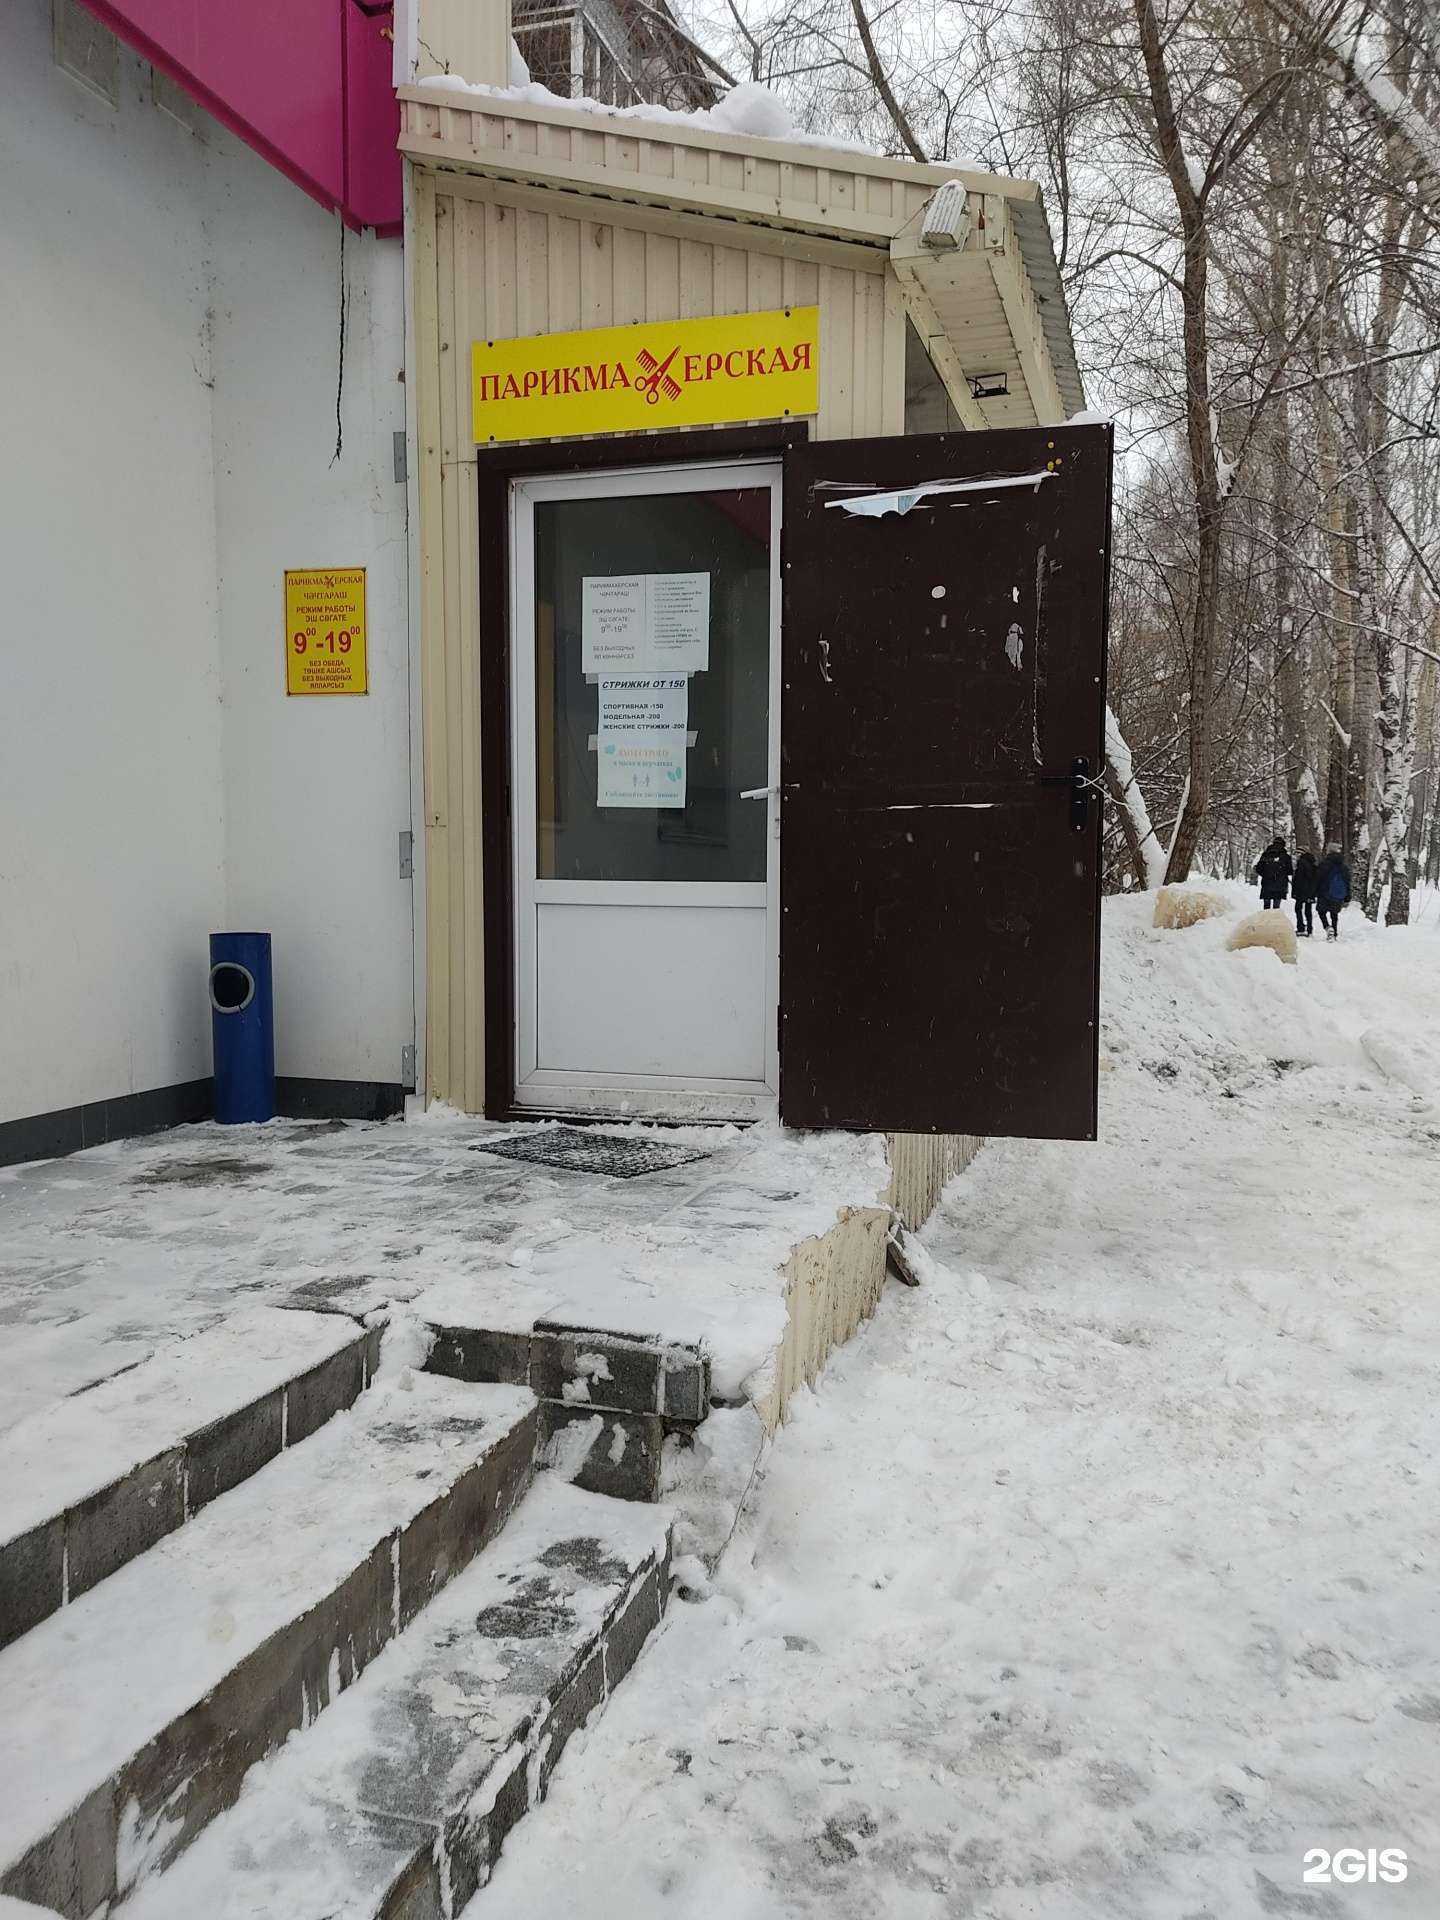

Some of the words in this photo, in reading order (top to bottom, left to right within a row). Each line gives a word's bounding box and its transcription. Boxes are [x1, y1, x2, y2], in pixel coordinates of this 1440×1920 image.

[296, 606, 323, 614] РЕЖИМ
[324, 605, 356, 613] РАБОТЫ
[322, 659, 345, 667] ОБЕДА
[602, 681, 650, 689] СТРИЖКИ
[652, 680, 667, 688] ОТ
[668, 680, 686, 688] 150
